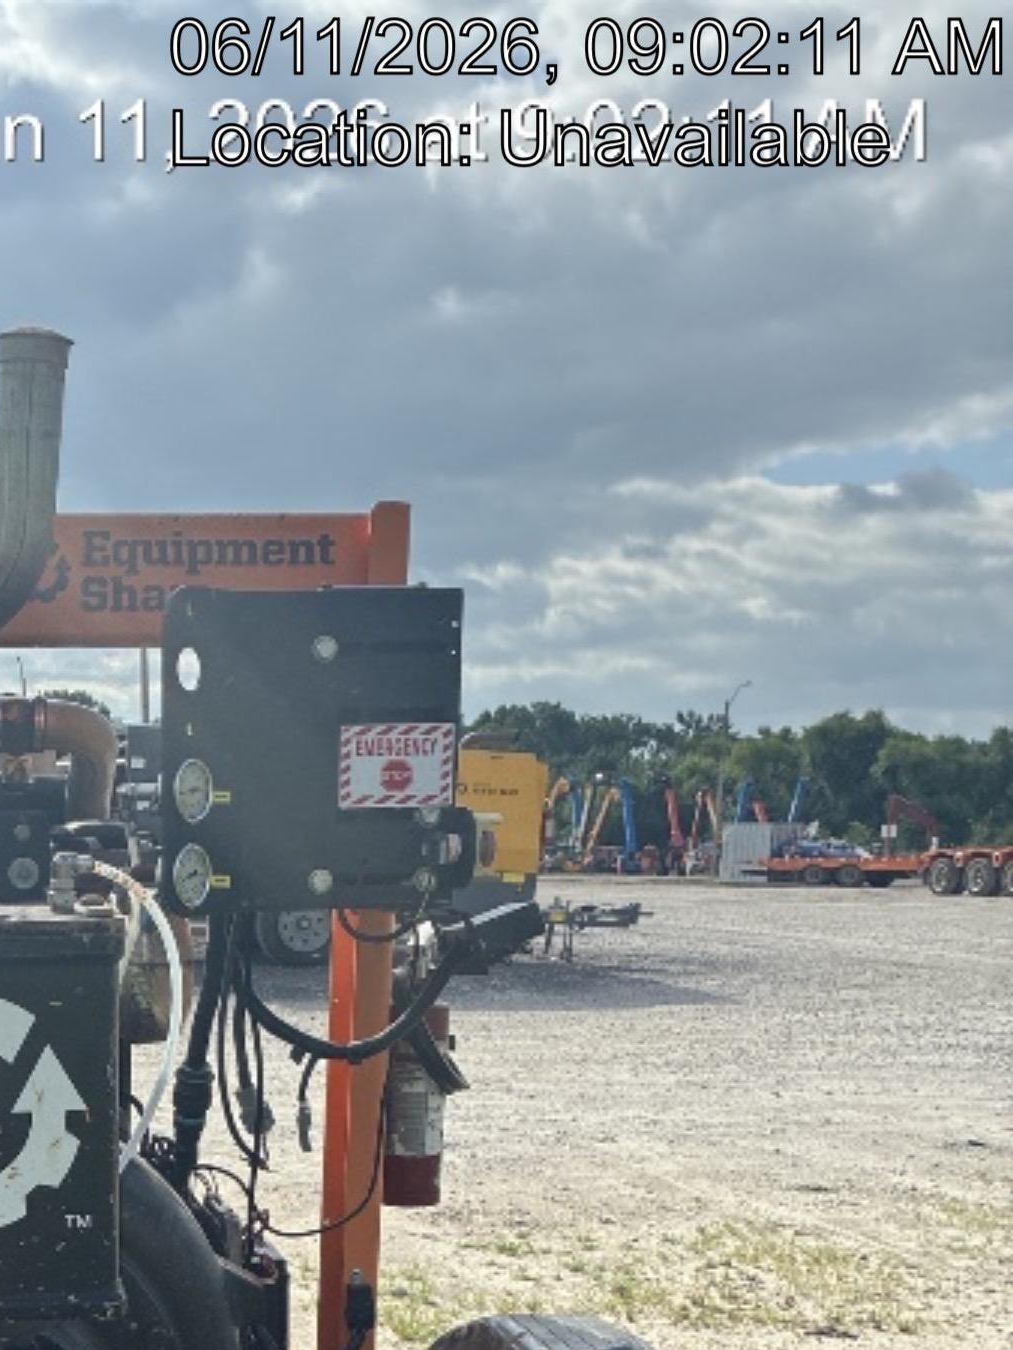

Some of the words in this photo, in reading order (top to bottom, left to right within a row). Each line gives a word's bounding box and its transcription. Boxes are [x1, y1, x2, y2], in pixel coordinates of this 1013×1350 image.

[81, 530, 337, 576] Equipment
[81, 575, 176, 613] Sha
[354, 736, 439, 757] EMERGENCY
[64, 1213, 93, 1229] TM
